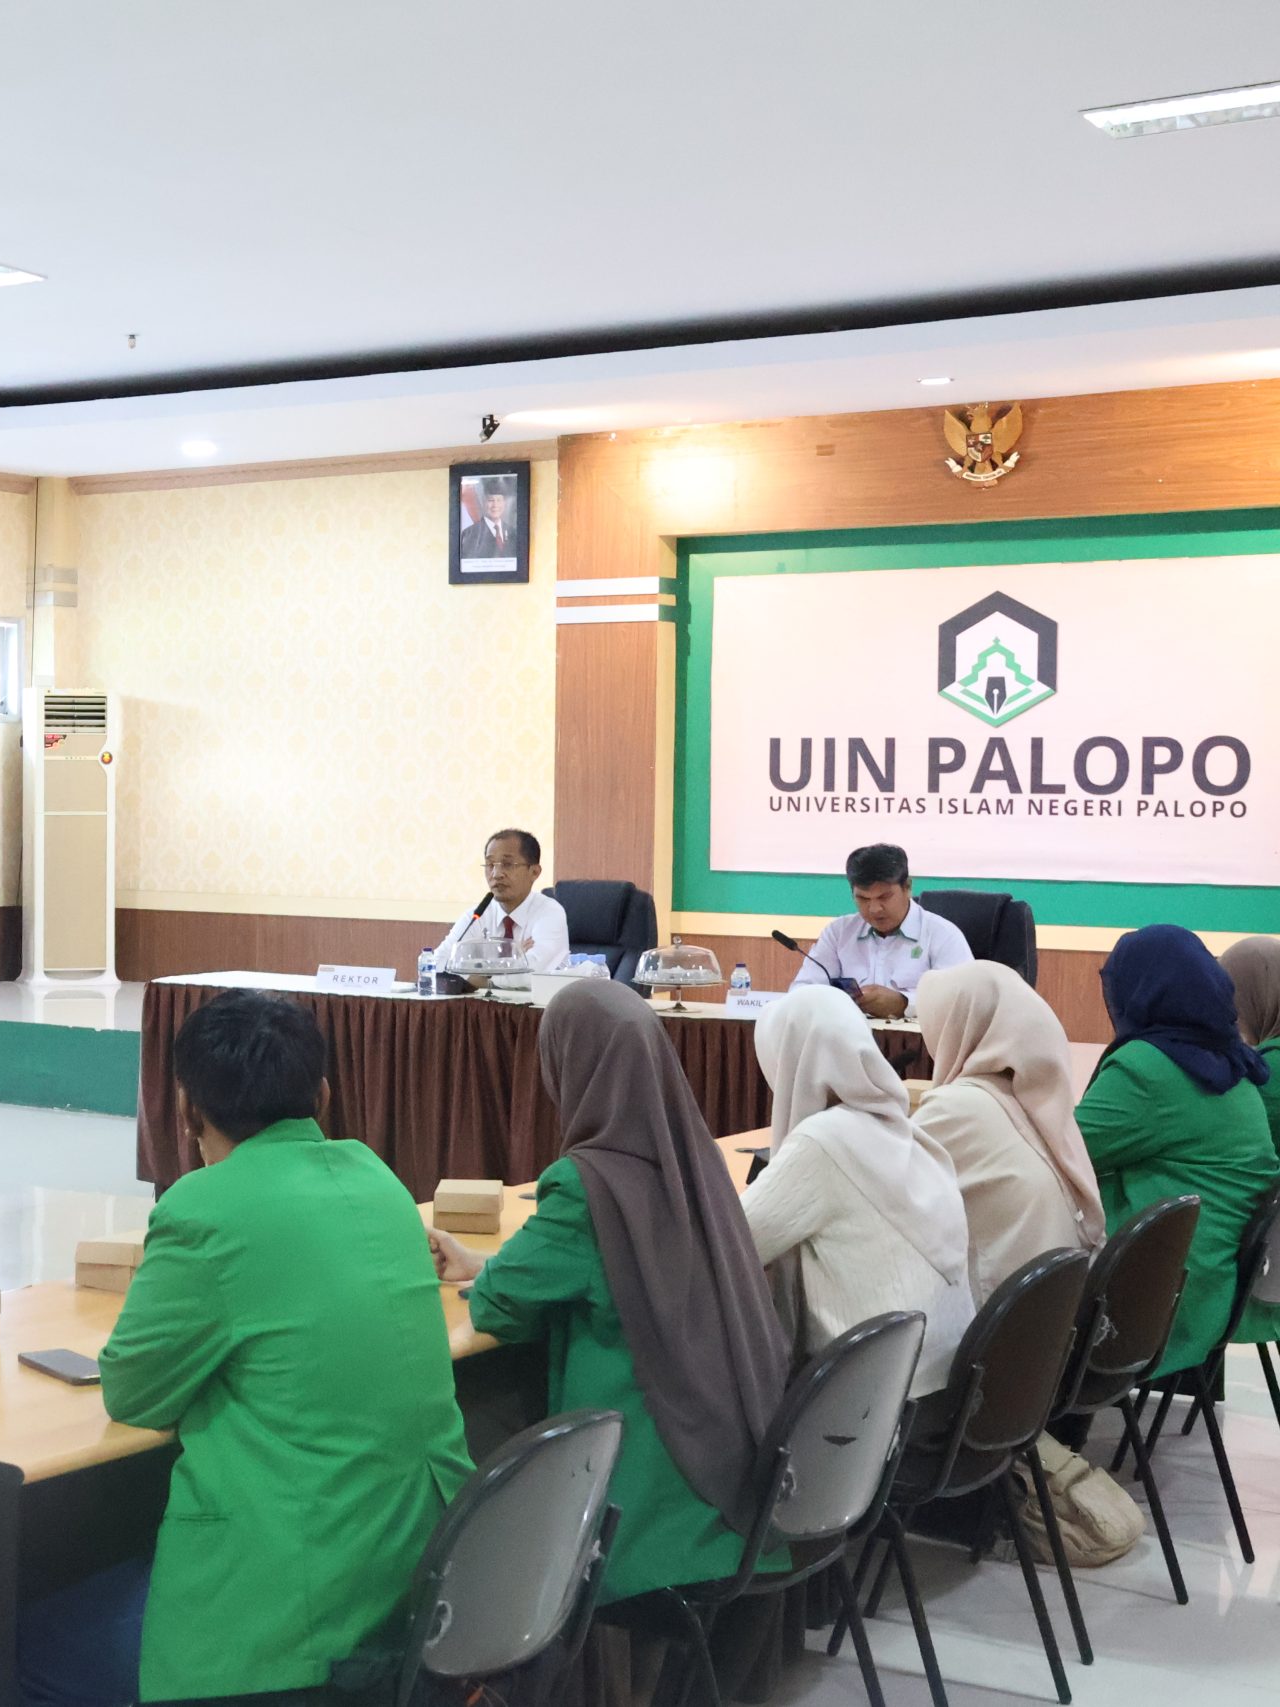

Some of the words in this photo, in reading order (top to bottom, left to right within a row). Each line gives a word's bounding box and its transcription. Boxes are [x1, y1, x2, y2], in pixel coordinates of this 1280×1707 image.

[769, 737, 896, 793] UIN
[927, 735, 1251, 796] PALOPO
[770, 796, 926, 814] UNIVERSITAS
[938, 798, 1014, 815] ISLAM
[1028, 799, 1122, 817] NEGERI
[1137, 800, 1247, 818] PALOPO
[332, 974, 379, 985] REKTOR
[737, 999, 763, 1007] WAKIL
